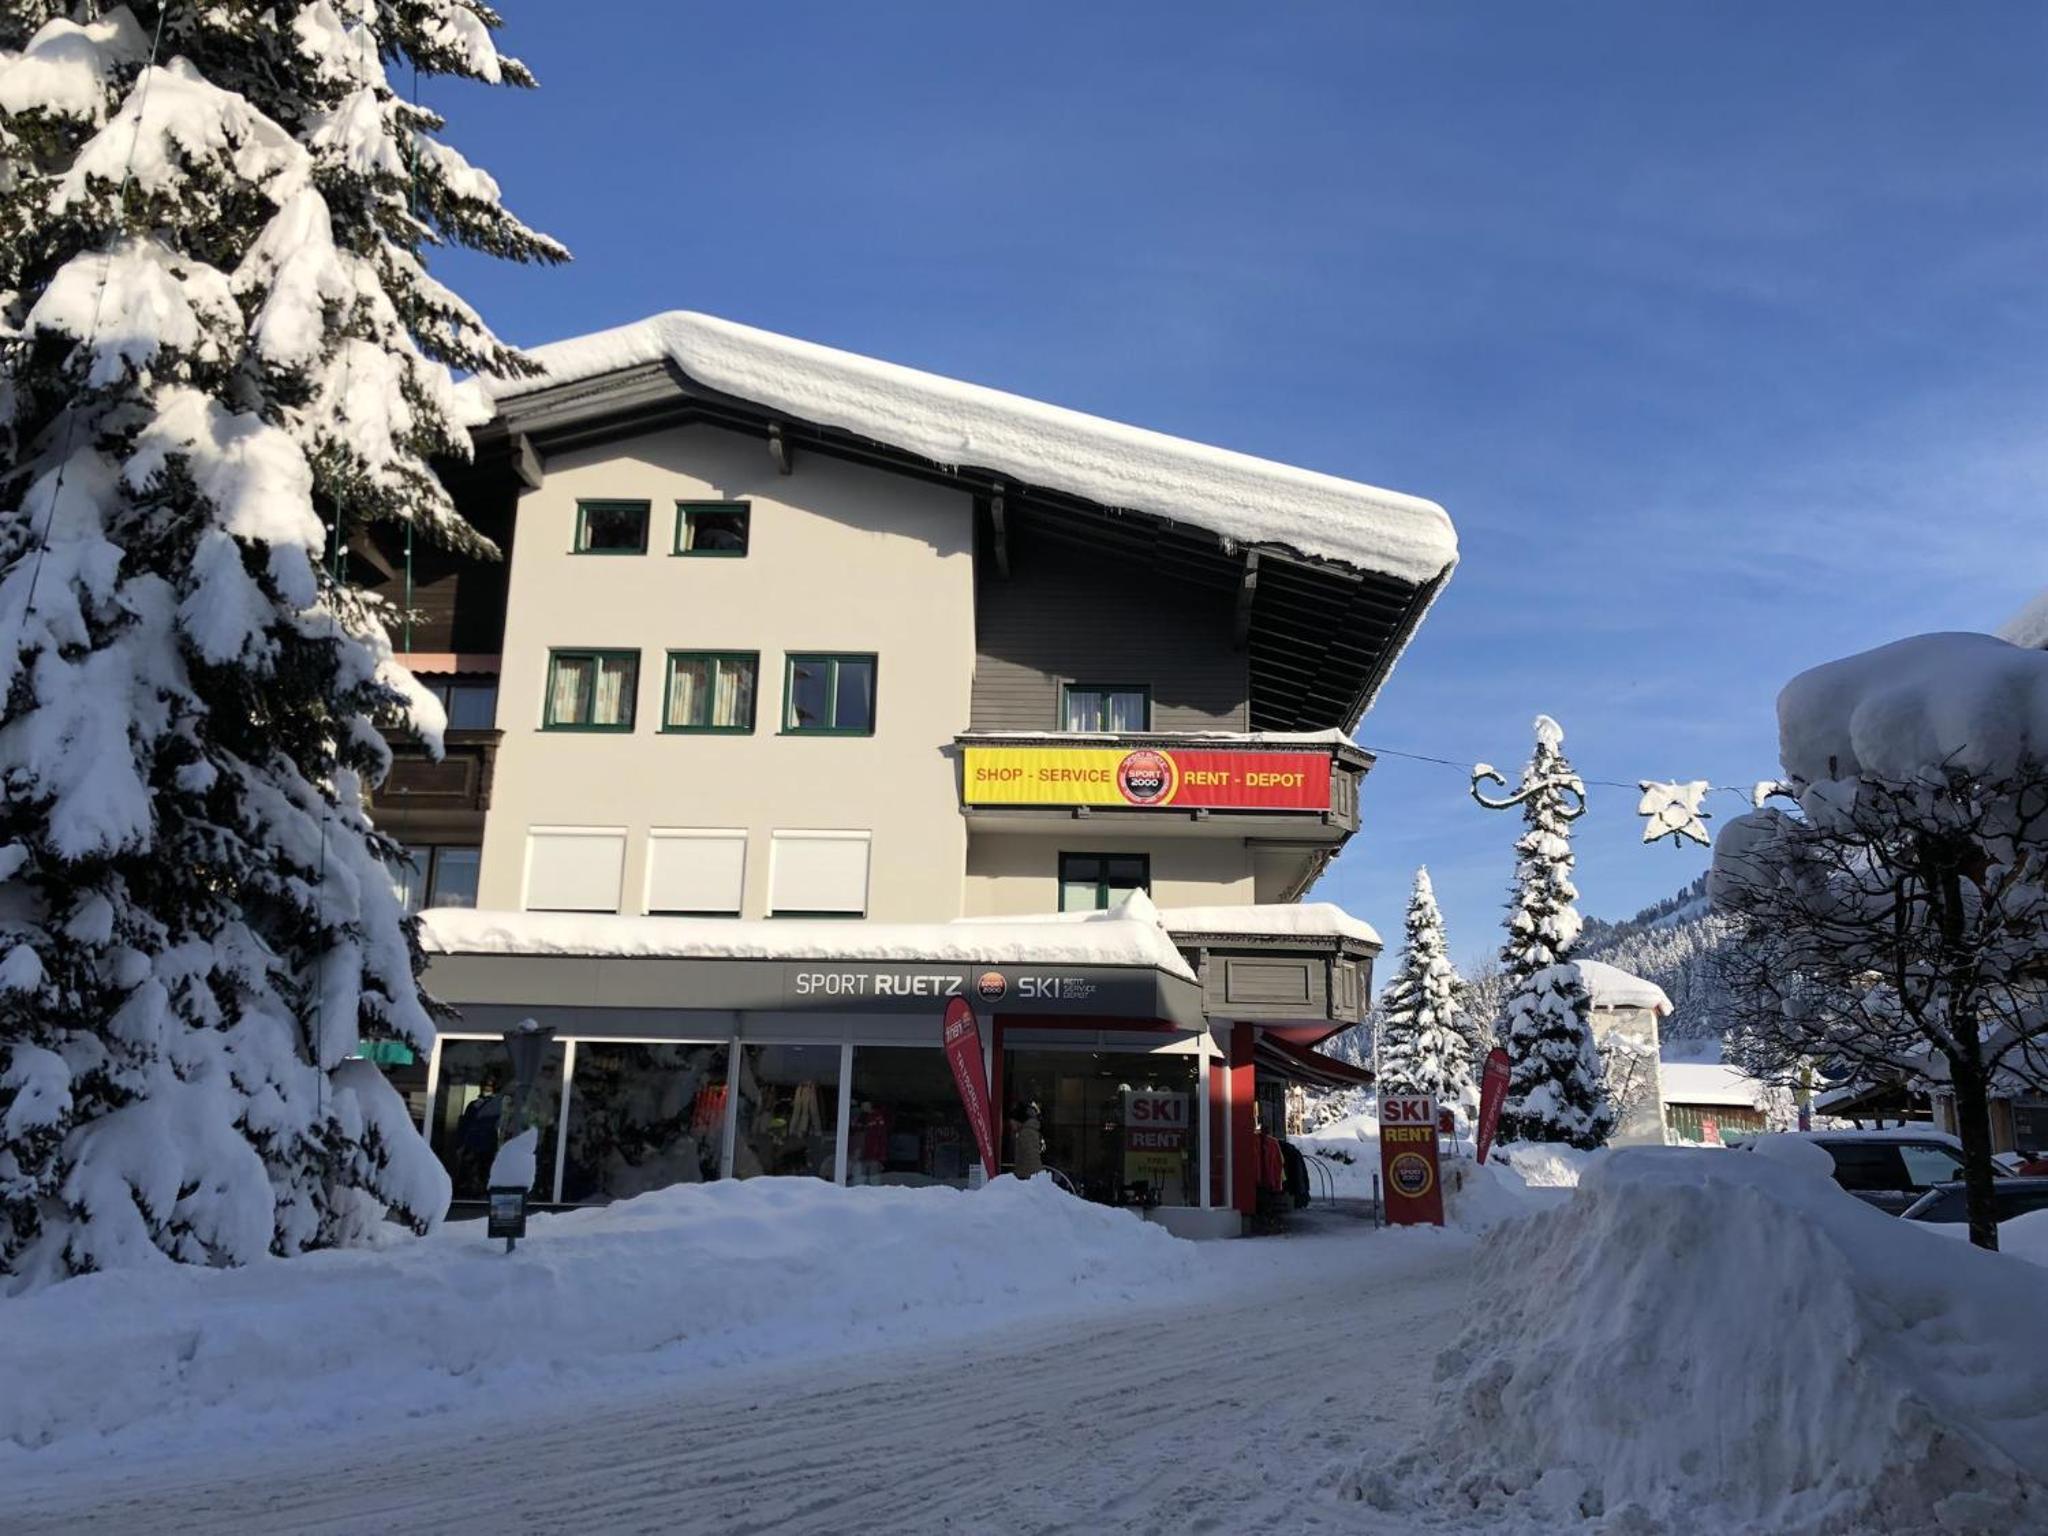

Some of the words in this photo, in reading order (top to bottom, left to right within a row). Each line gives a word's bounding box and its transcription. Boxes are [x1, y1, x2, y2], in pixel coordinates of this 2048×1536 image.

[976, 767, 1023, 782] SHOP
[1039, 768, 1111, 783] SERVICE
[1128, 769, 1161, 778] SPORT
[1184, 771, 1229, 786] RENT
[1246, 773, 1304, 788] DEPOT
[1131, 778, 1159, 786] 2000
[796, 973, 868, 995] SPORT
[874, 974, 964, 996] RUETZ
[1018, 977, 1060, 998] SKI
[1133, 1099, 1181, 1121] SKI
[1384, 1100, 1430, 1121] SKI
[1132, 1133, 1181, 1148] RENT
[1384, 1127, 1433, 1142] RENT
